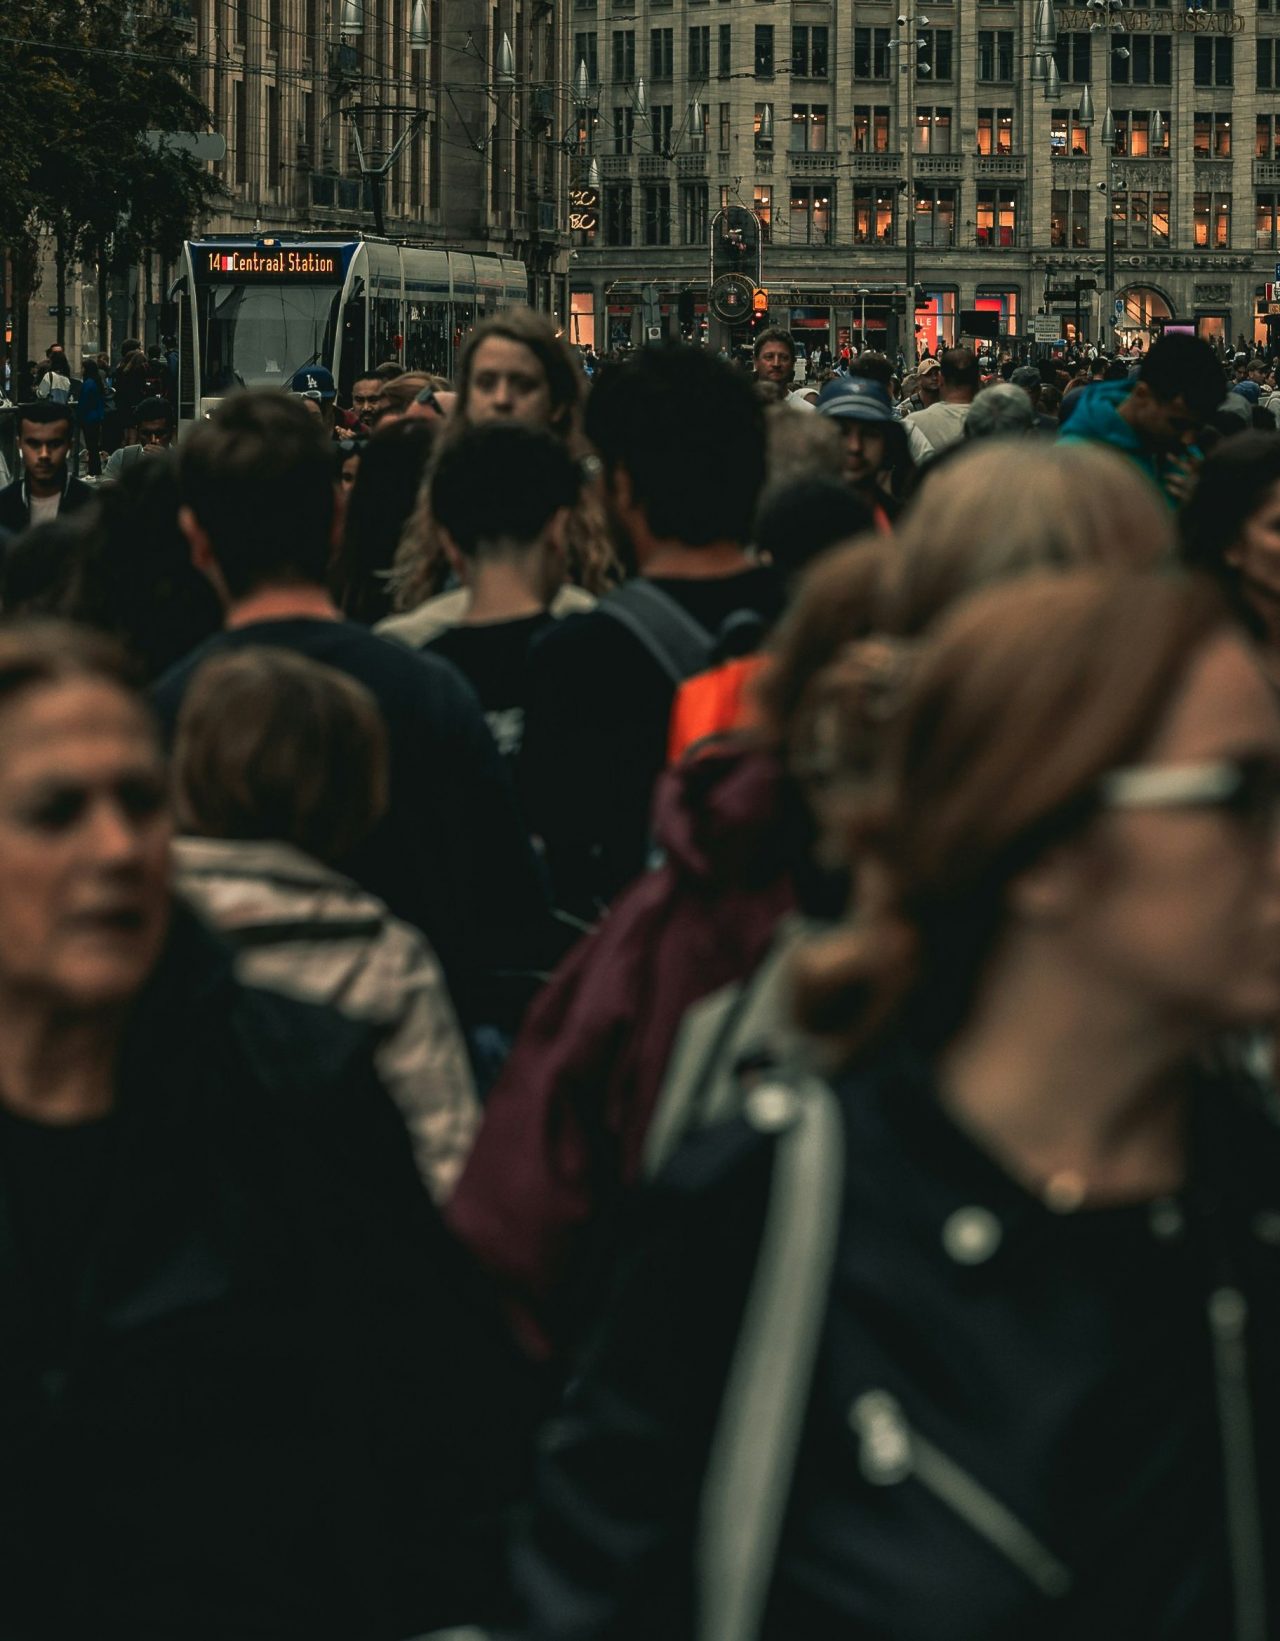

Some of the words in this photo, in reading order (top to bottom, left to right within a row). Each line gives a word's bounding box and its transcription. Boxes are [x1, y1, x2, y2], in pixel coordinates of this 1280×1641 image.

[208, 252, 221, 271] 14
[232, 252, 284, 272] Centraal
[288, 252, 333, 272] Station
